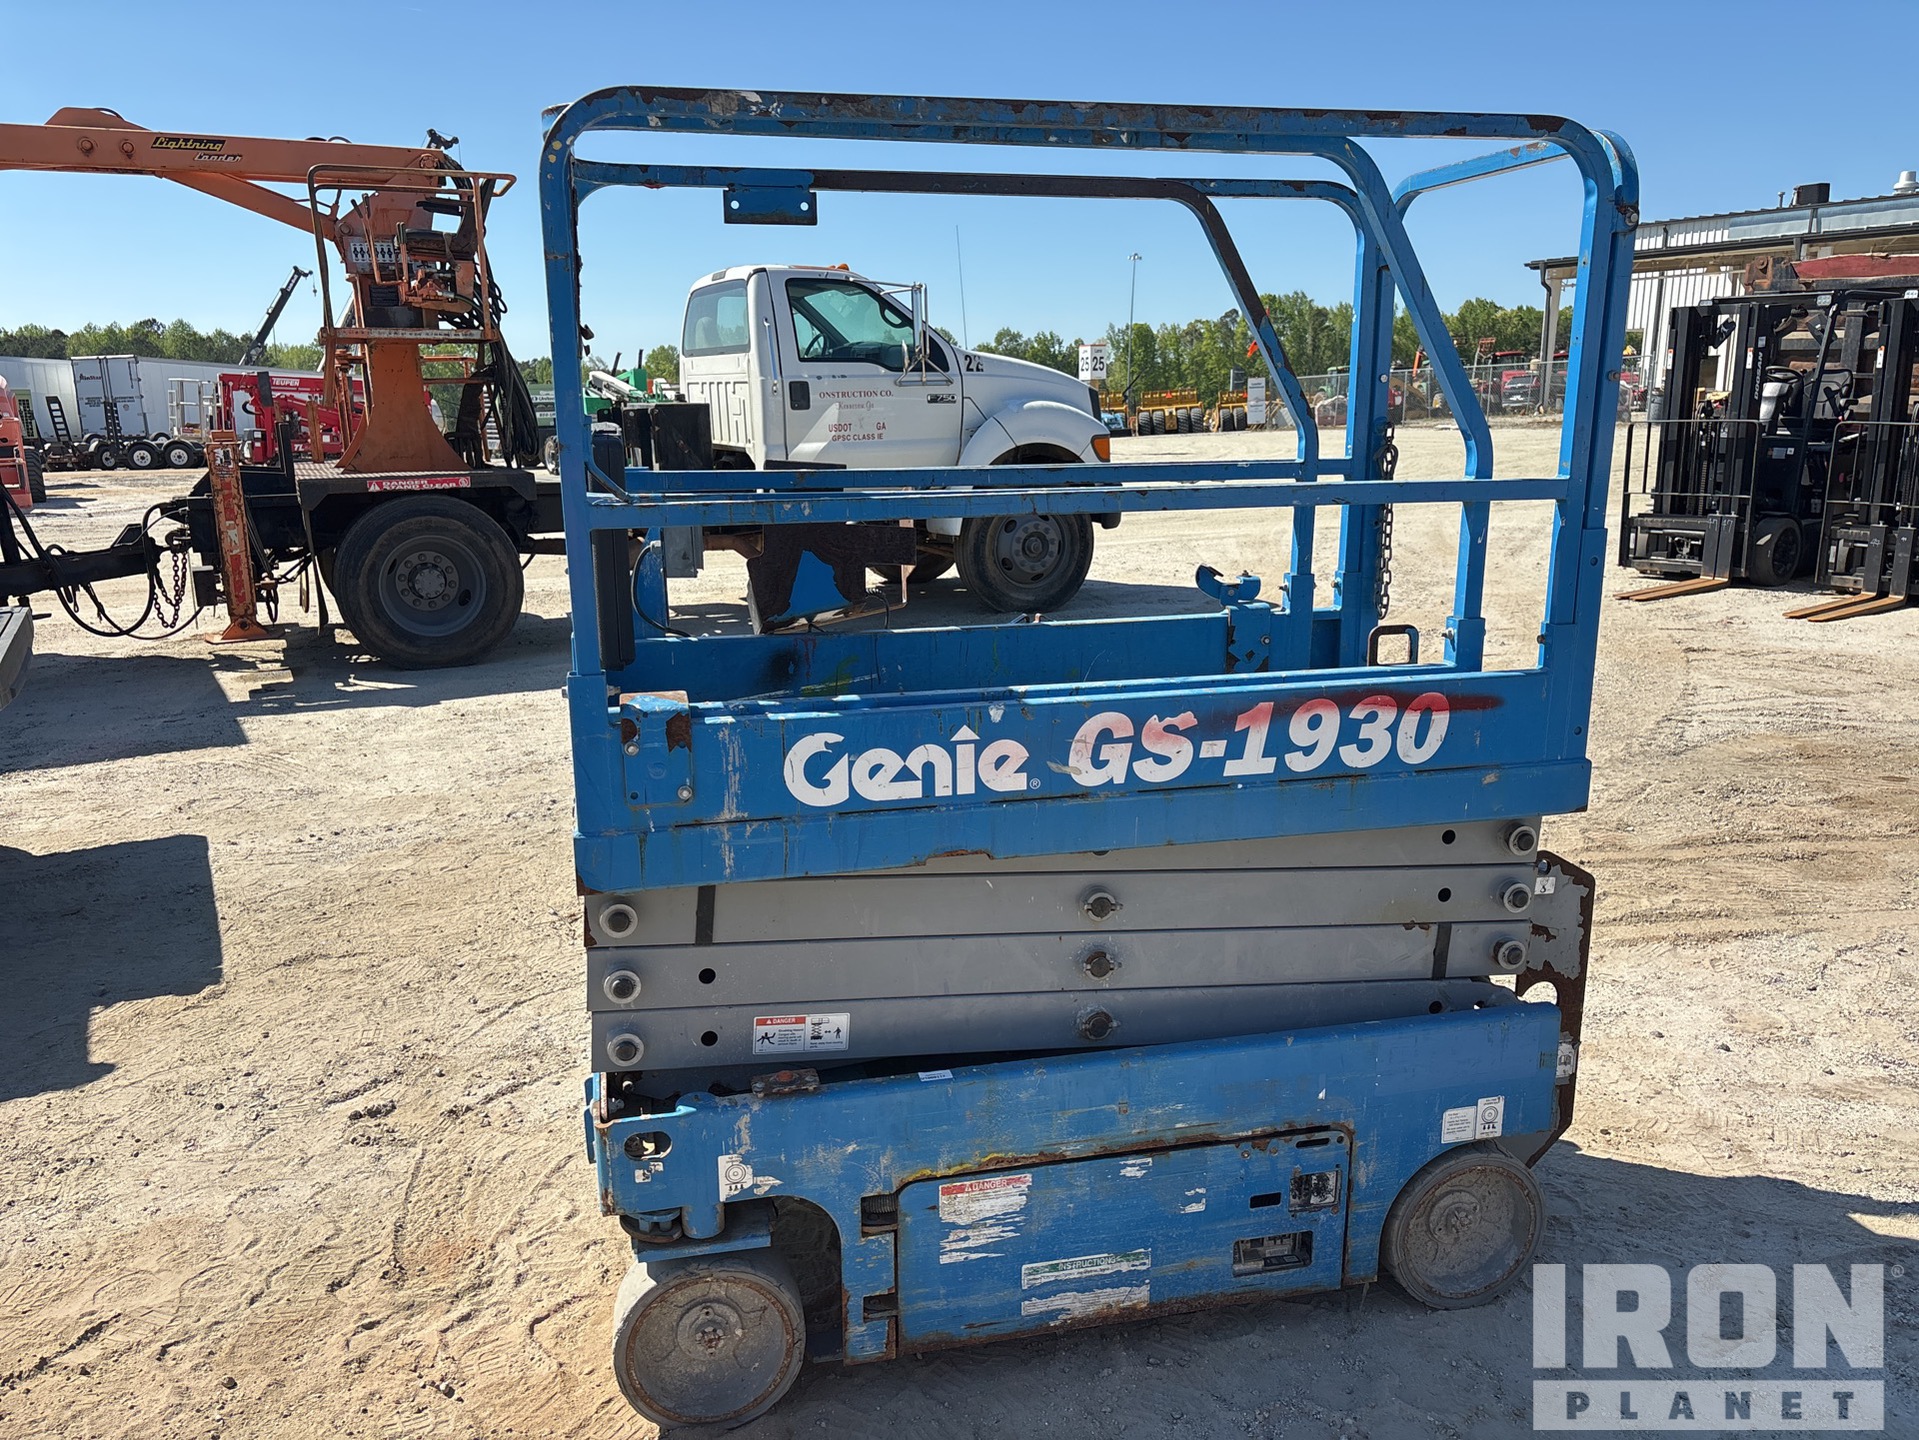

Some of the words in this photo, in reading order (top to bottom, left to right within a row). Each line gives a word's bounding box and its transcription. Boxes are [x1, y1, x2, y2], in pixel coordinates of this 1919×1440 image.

[152, 137, 223, 151] Lightning
[194, 152, 242, 162] Loader
[1080, 357, 1089, 371] 25
[1092, 356, 1104, 371] 25
[1754, 352, 1763, 400] DOOSAN
[272, 377, 300, 387] TEUPEN
[879, 389, 894, 397] CO.
[828, 423, 852, 432] USDOT
[876, 421, 887, 431] GA
[831, 434, 851, 442] GPSC
[852, 433, 876, 441] CLASS
[783, 725, 1029, 808] Genie
[1068, 691, 1451, 787] GS-1930
[972, 1180, 1008, 1191] DANGER
